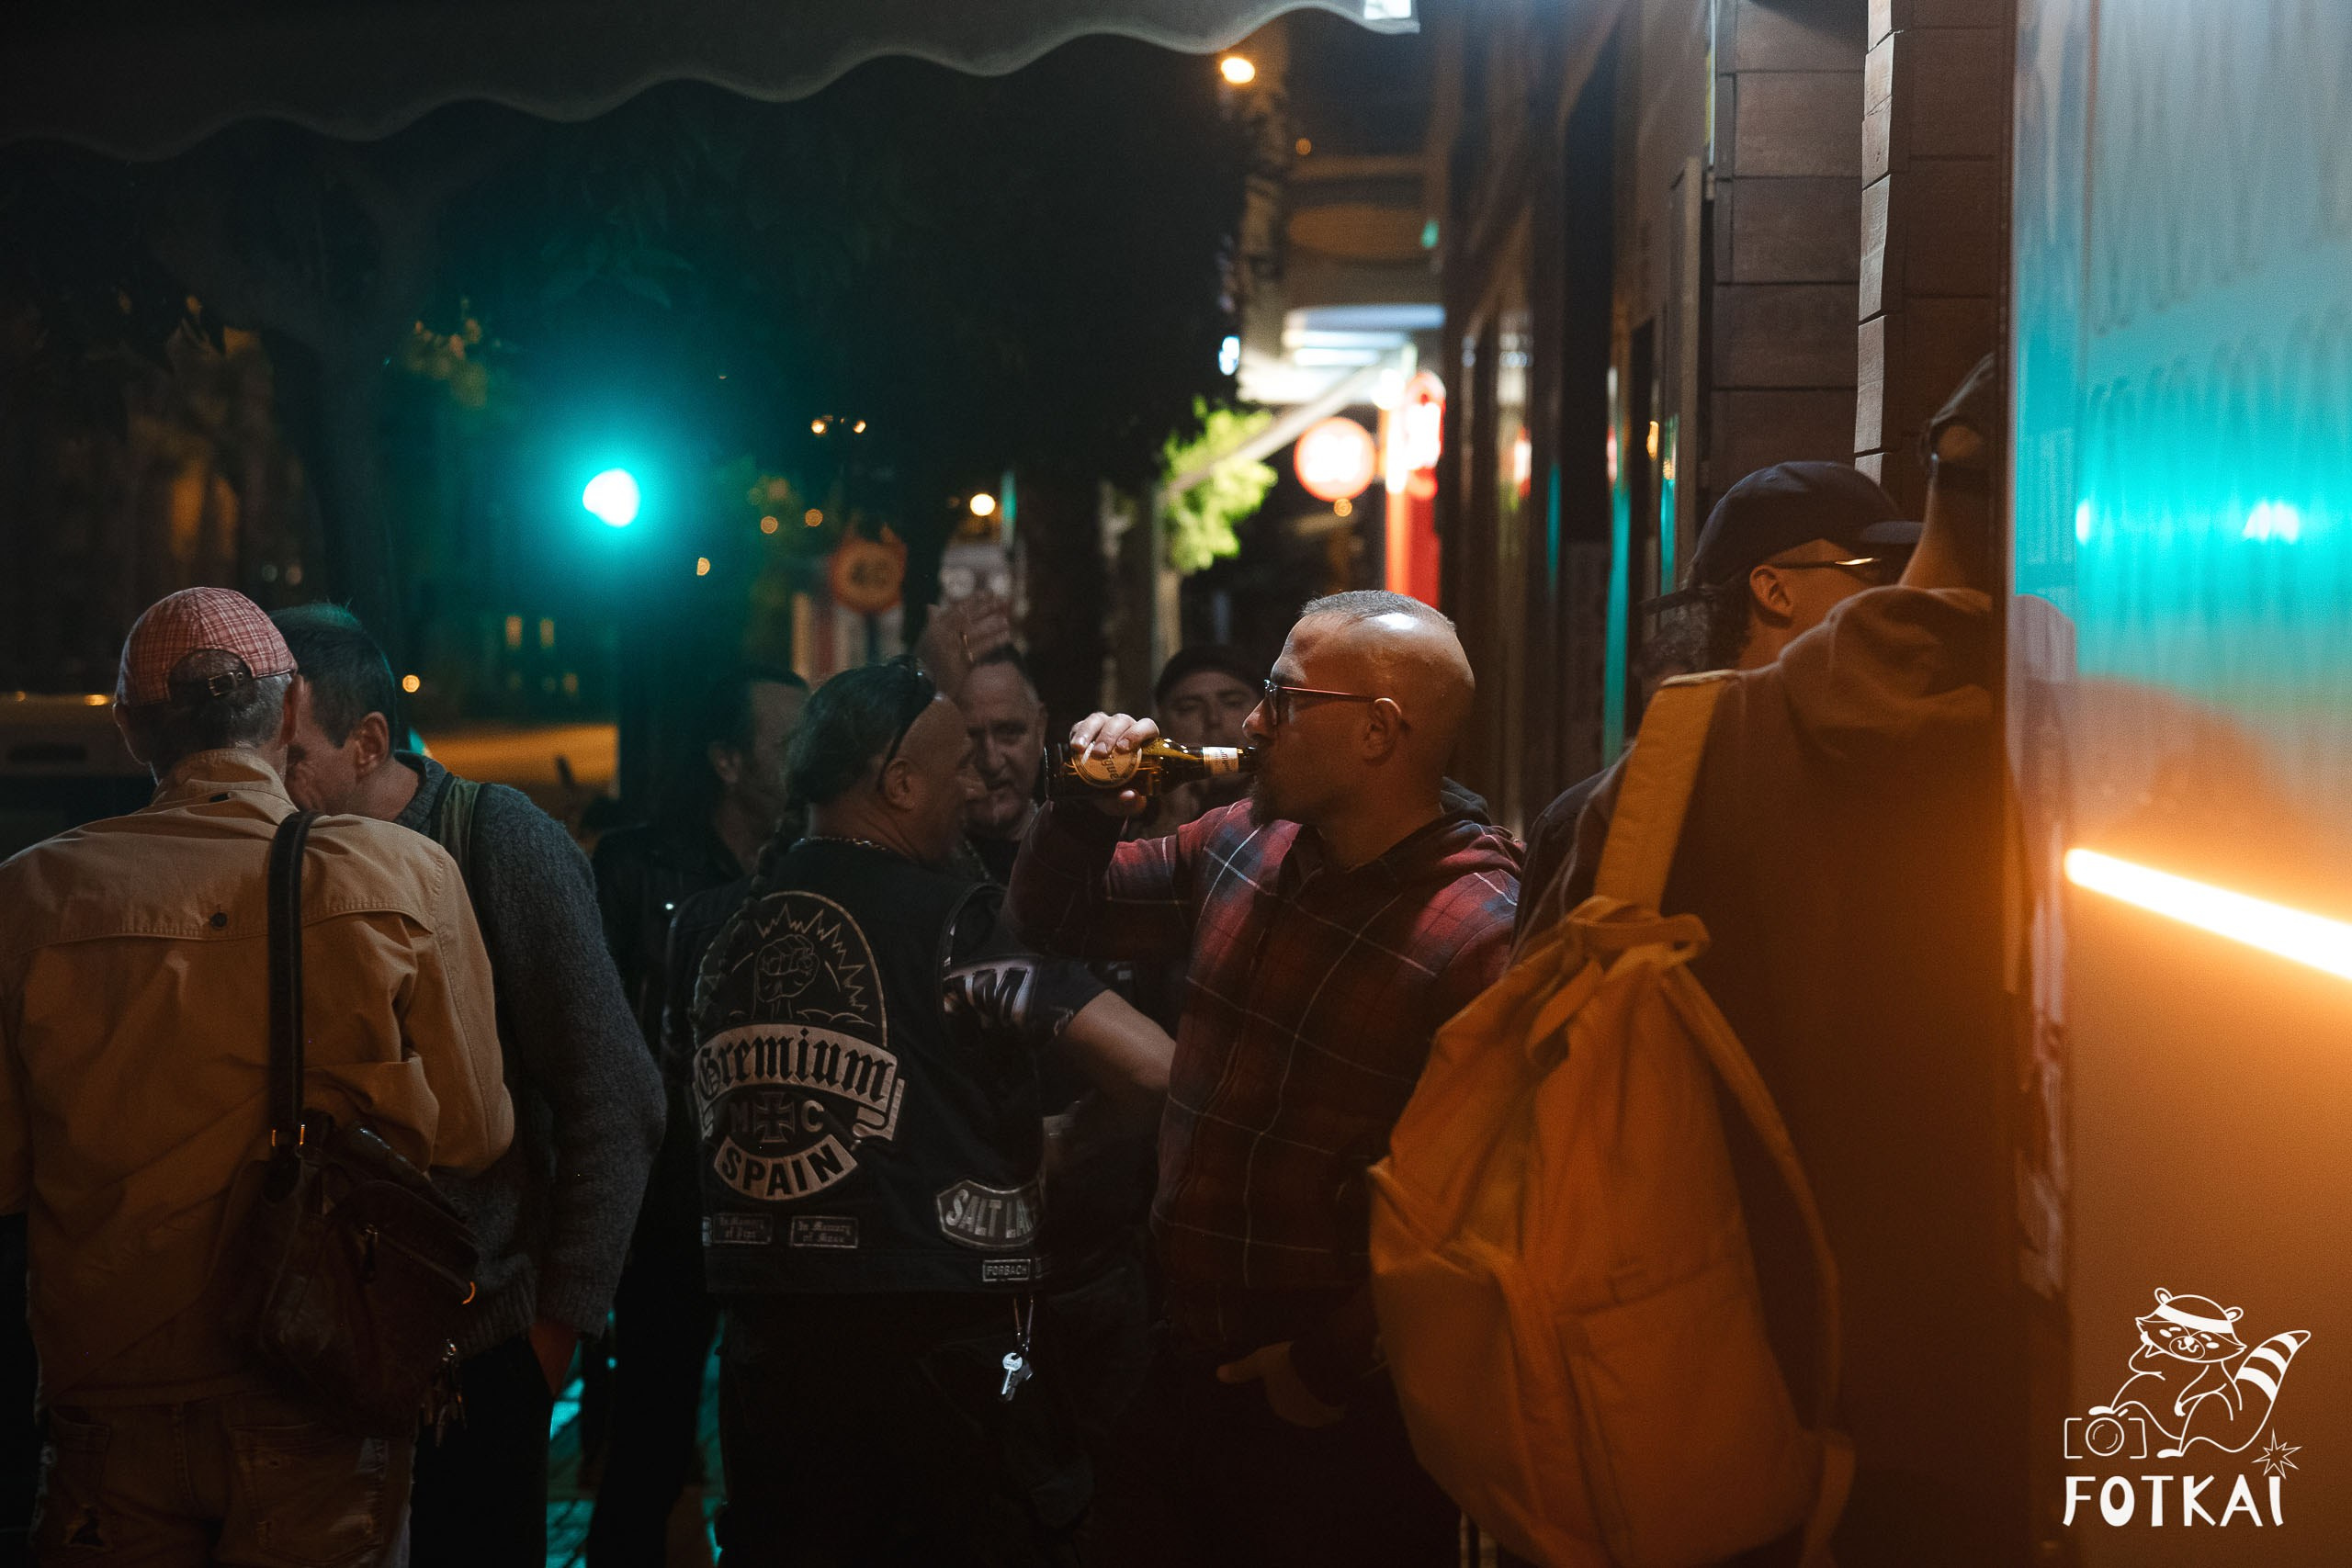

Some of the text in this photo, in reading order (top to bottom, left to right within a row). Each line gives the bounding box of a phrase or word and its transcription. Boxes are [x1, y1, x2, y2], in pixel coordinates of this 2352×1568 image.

[698, 1027, 894, 1102] Gremium
[800, 1099, 825, 1133] C
[721, 1143, 845, 1197] SPAIN
[945, 1189, 1002, 1238] SALT
[986, 1264, 1028, 1277] FORBACH
